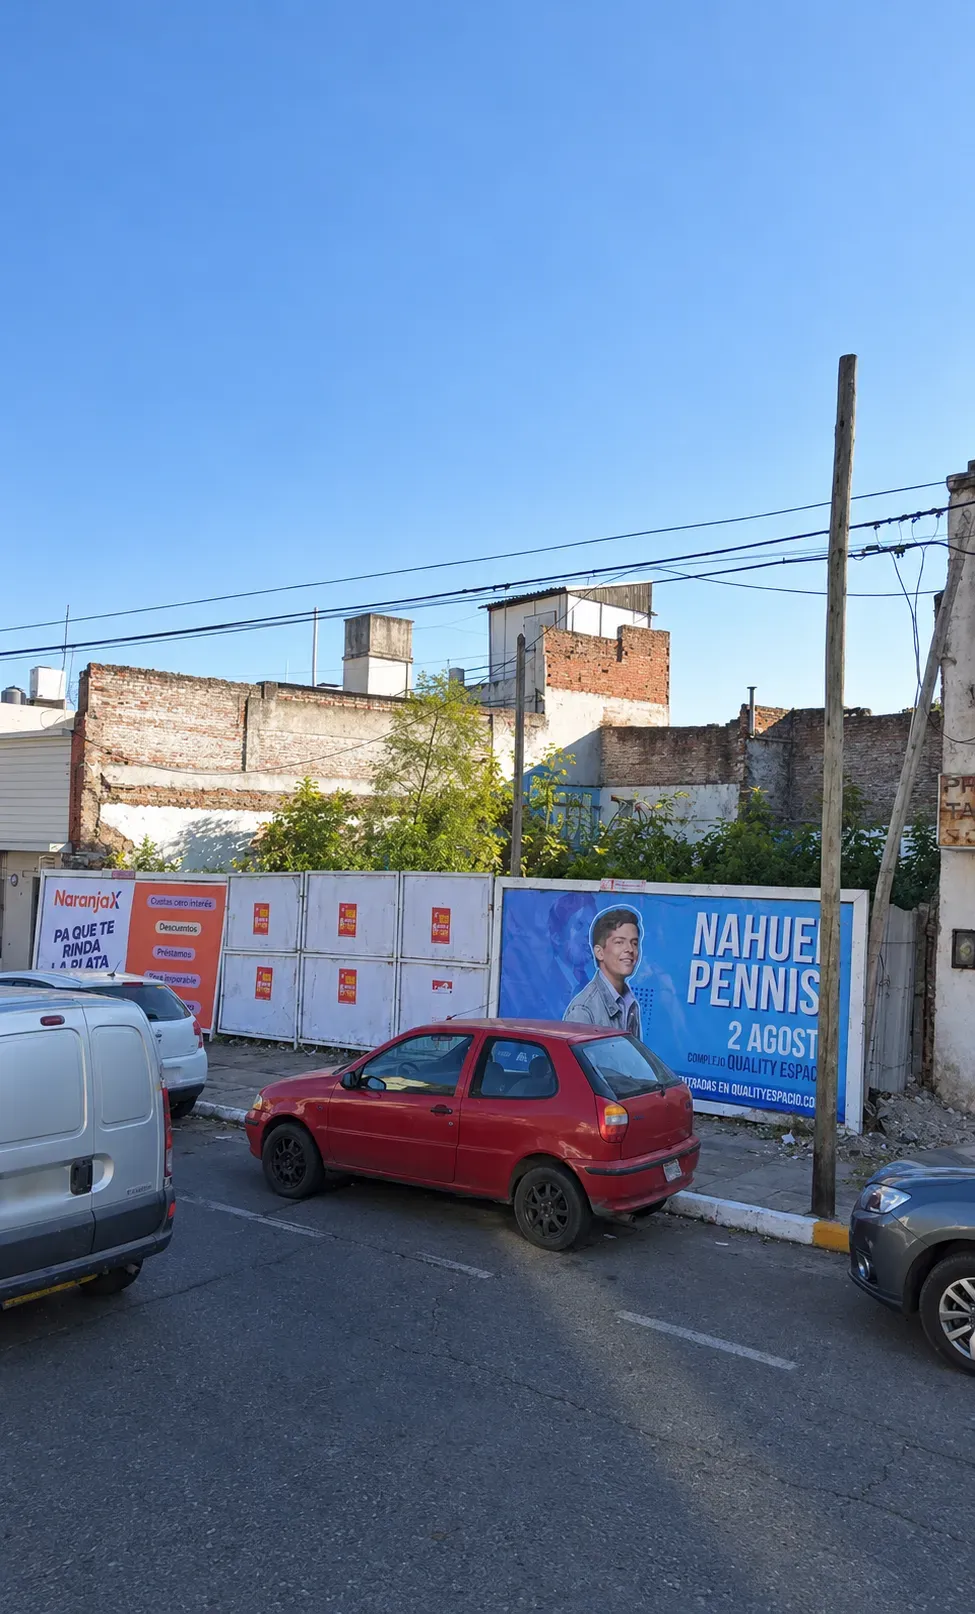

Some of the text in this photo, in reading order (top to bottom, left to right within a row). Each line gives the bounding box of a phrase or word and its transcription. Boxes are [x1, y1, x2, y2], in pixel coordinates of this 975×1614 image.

[53, 920, 115, 943] PA QUE TE
[159, 922, 198, 933] Descuentos
[62, 938, 101, 958] RINDA
[157, 947, 192, 958] Préstamos
[687, 959, 819, 1016] PENNIS
[727, 1020, 818, 1060] 2 AGOST
[687, 1052, 817, 1082] COMPLEJO QUALITY ESPAC
[718, 1081, 729, 1094] EN
[731, 1083, 815, 1108] QUALITYESPACIO.CO
